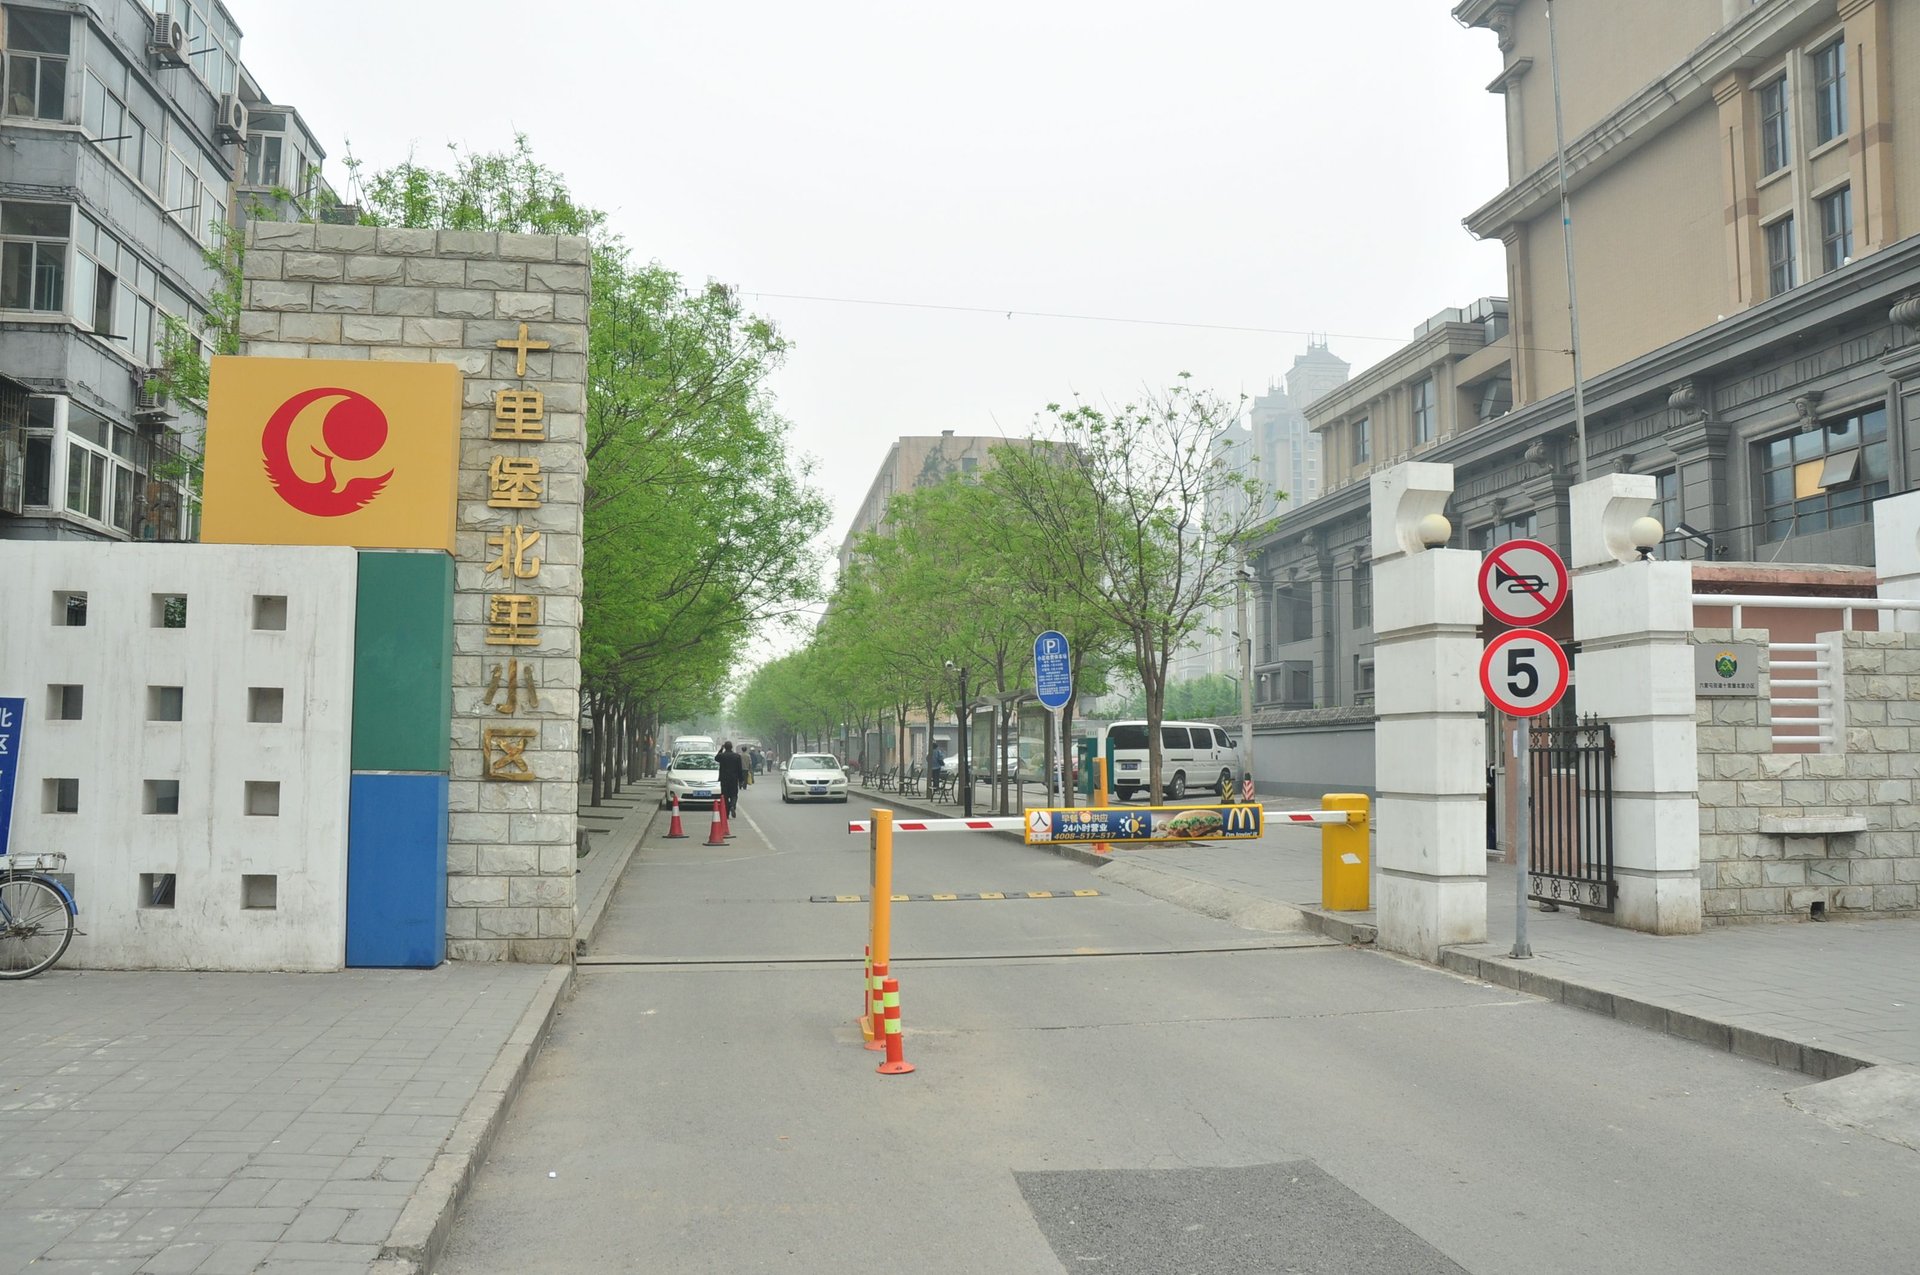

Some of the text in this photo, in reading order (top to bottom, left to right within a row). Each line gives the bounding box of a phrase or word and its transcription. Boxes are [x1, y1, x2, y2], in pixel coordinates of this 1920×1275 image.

[484, 323, 550, 781] 十里堡北里小区
[1046, 640, 1056, 654] P
[1507, 648, 1539, 698] 5
[1062, 823, 1108, 833] 24小时营业
[1054, 831, 1117, 840] 4008-517-517
